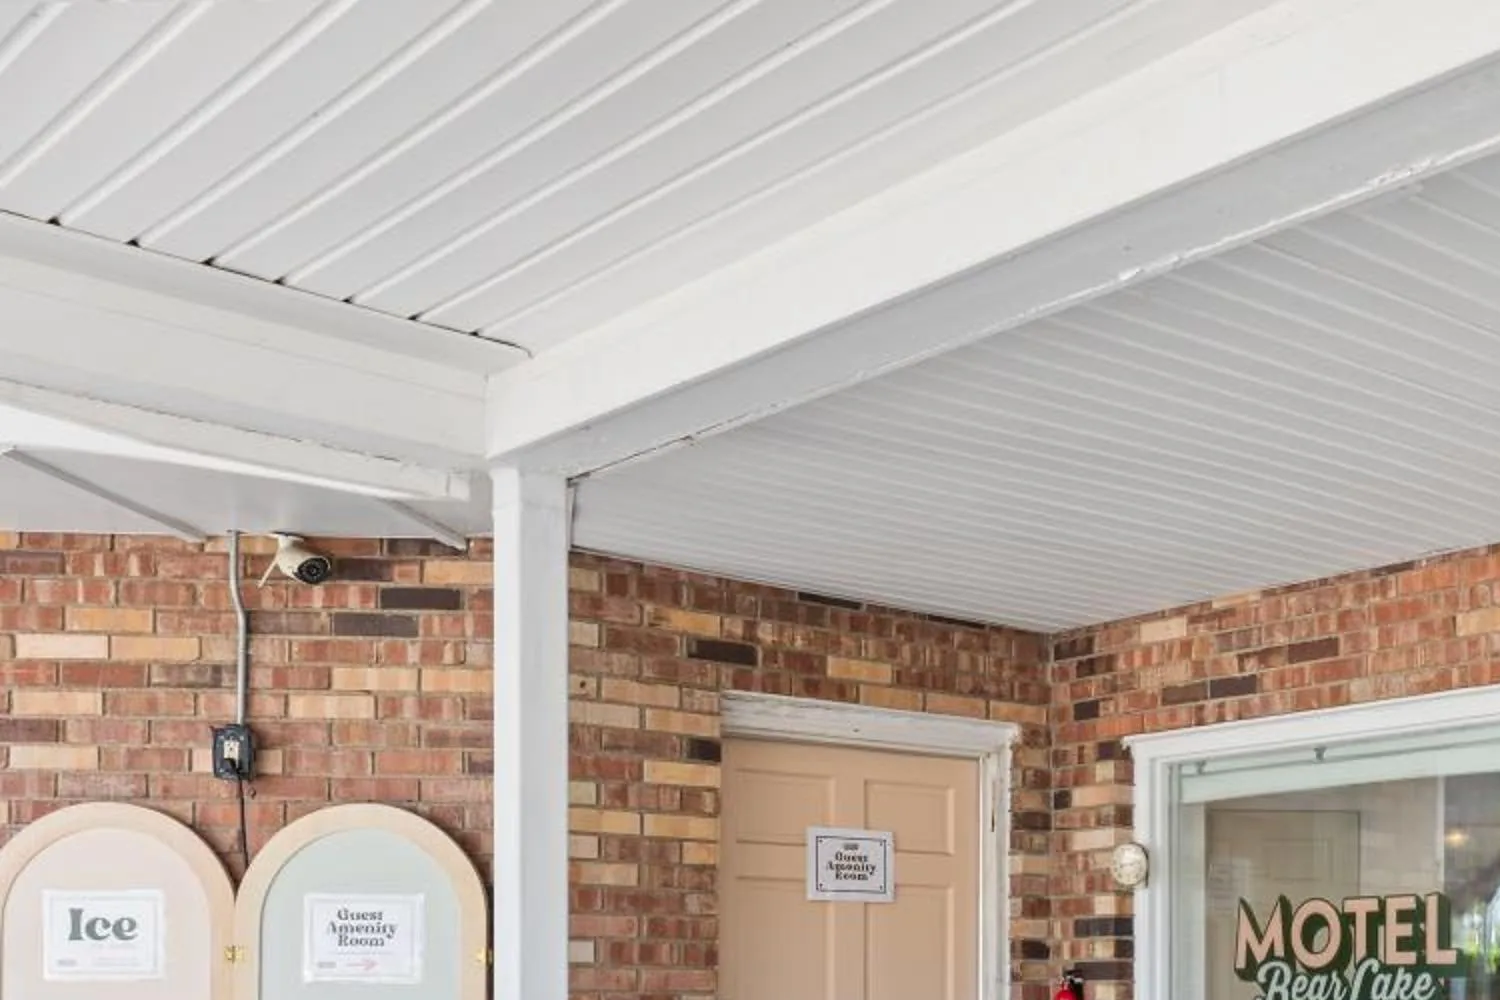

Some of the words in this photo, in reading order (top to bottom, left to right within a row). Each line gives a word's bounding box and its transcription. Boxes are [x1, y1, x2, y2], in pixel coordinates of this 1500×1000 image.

[68, 907, 138, 941] Ice
[337, 908, 384, 921] Guest
[327, 920, 398, 939] Amenity
[1234, 892, 1460, 972] MOTEL
[337, 935, 385, 947] Room
